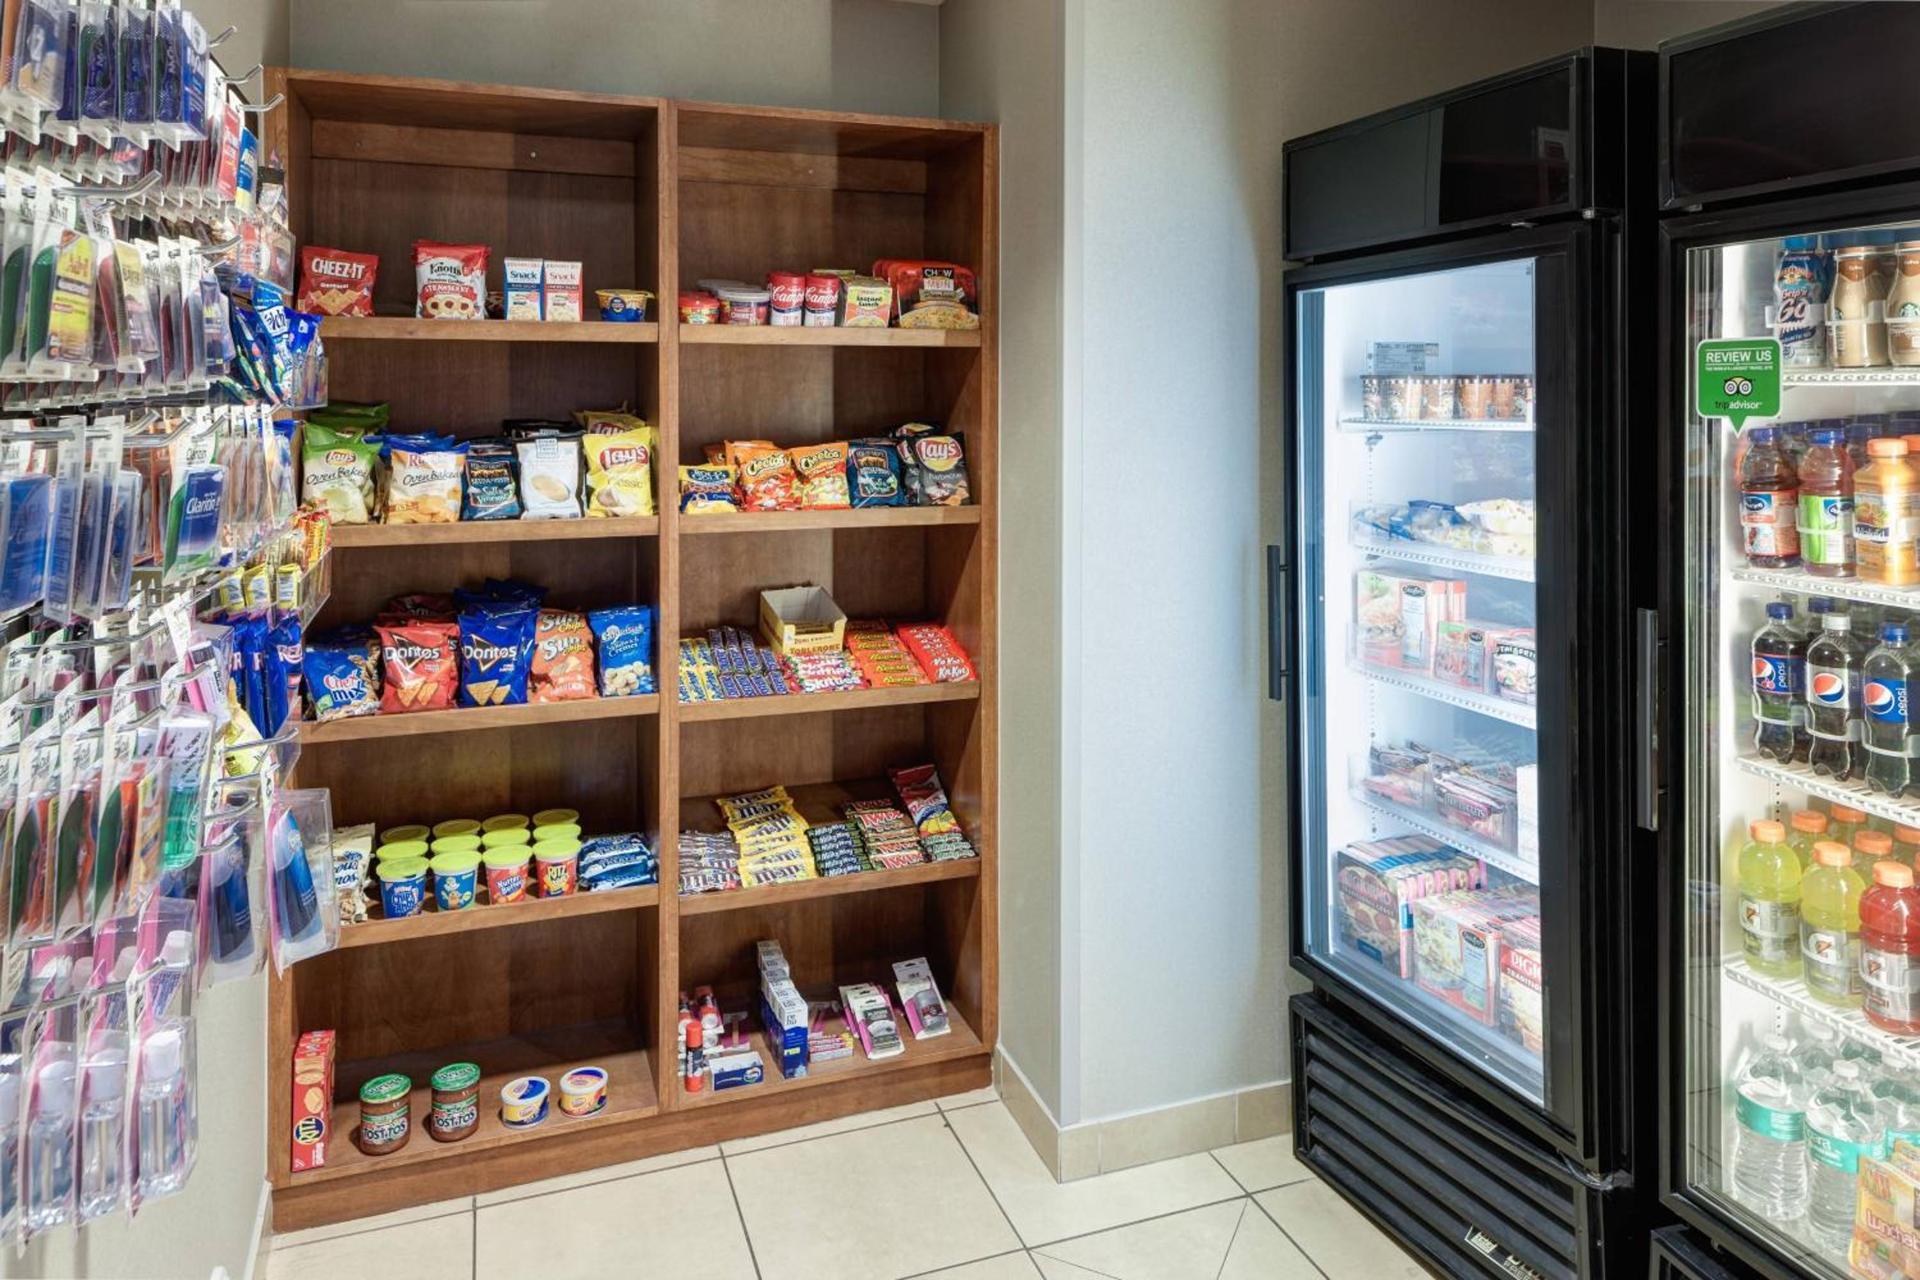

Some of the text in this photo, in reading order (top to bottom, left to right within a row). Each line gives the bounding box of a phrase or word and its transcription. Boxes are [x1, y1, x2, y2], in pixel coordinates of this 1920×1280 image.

[510, 270, 537, 280] Snack
[924, 268, 953, 278] CHW
[1705, 350, 1772, 362] REVIEW US
[1715, 400, 1760, 410] tripadvisor
[920, 440, 957, 460] Lay's
[800, 448, 841, 470] Cheetos
[306, 471, 338, 486] Oven
[402, 474, 430, 487] Oven
[384, 646, 440, 661] Doritos
[464, 646, 517, 660] Doritos
[1778, 661, 1787, 688] pepsi
